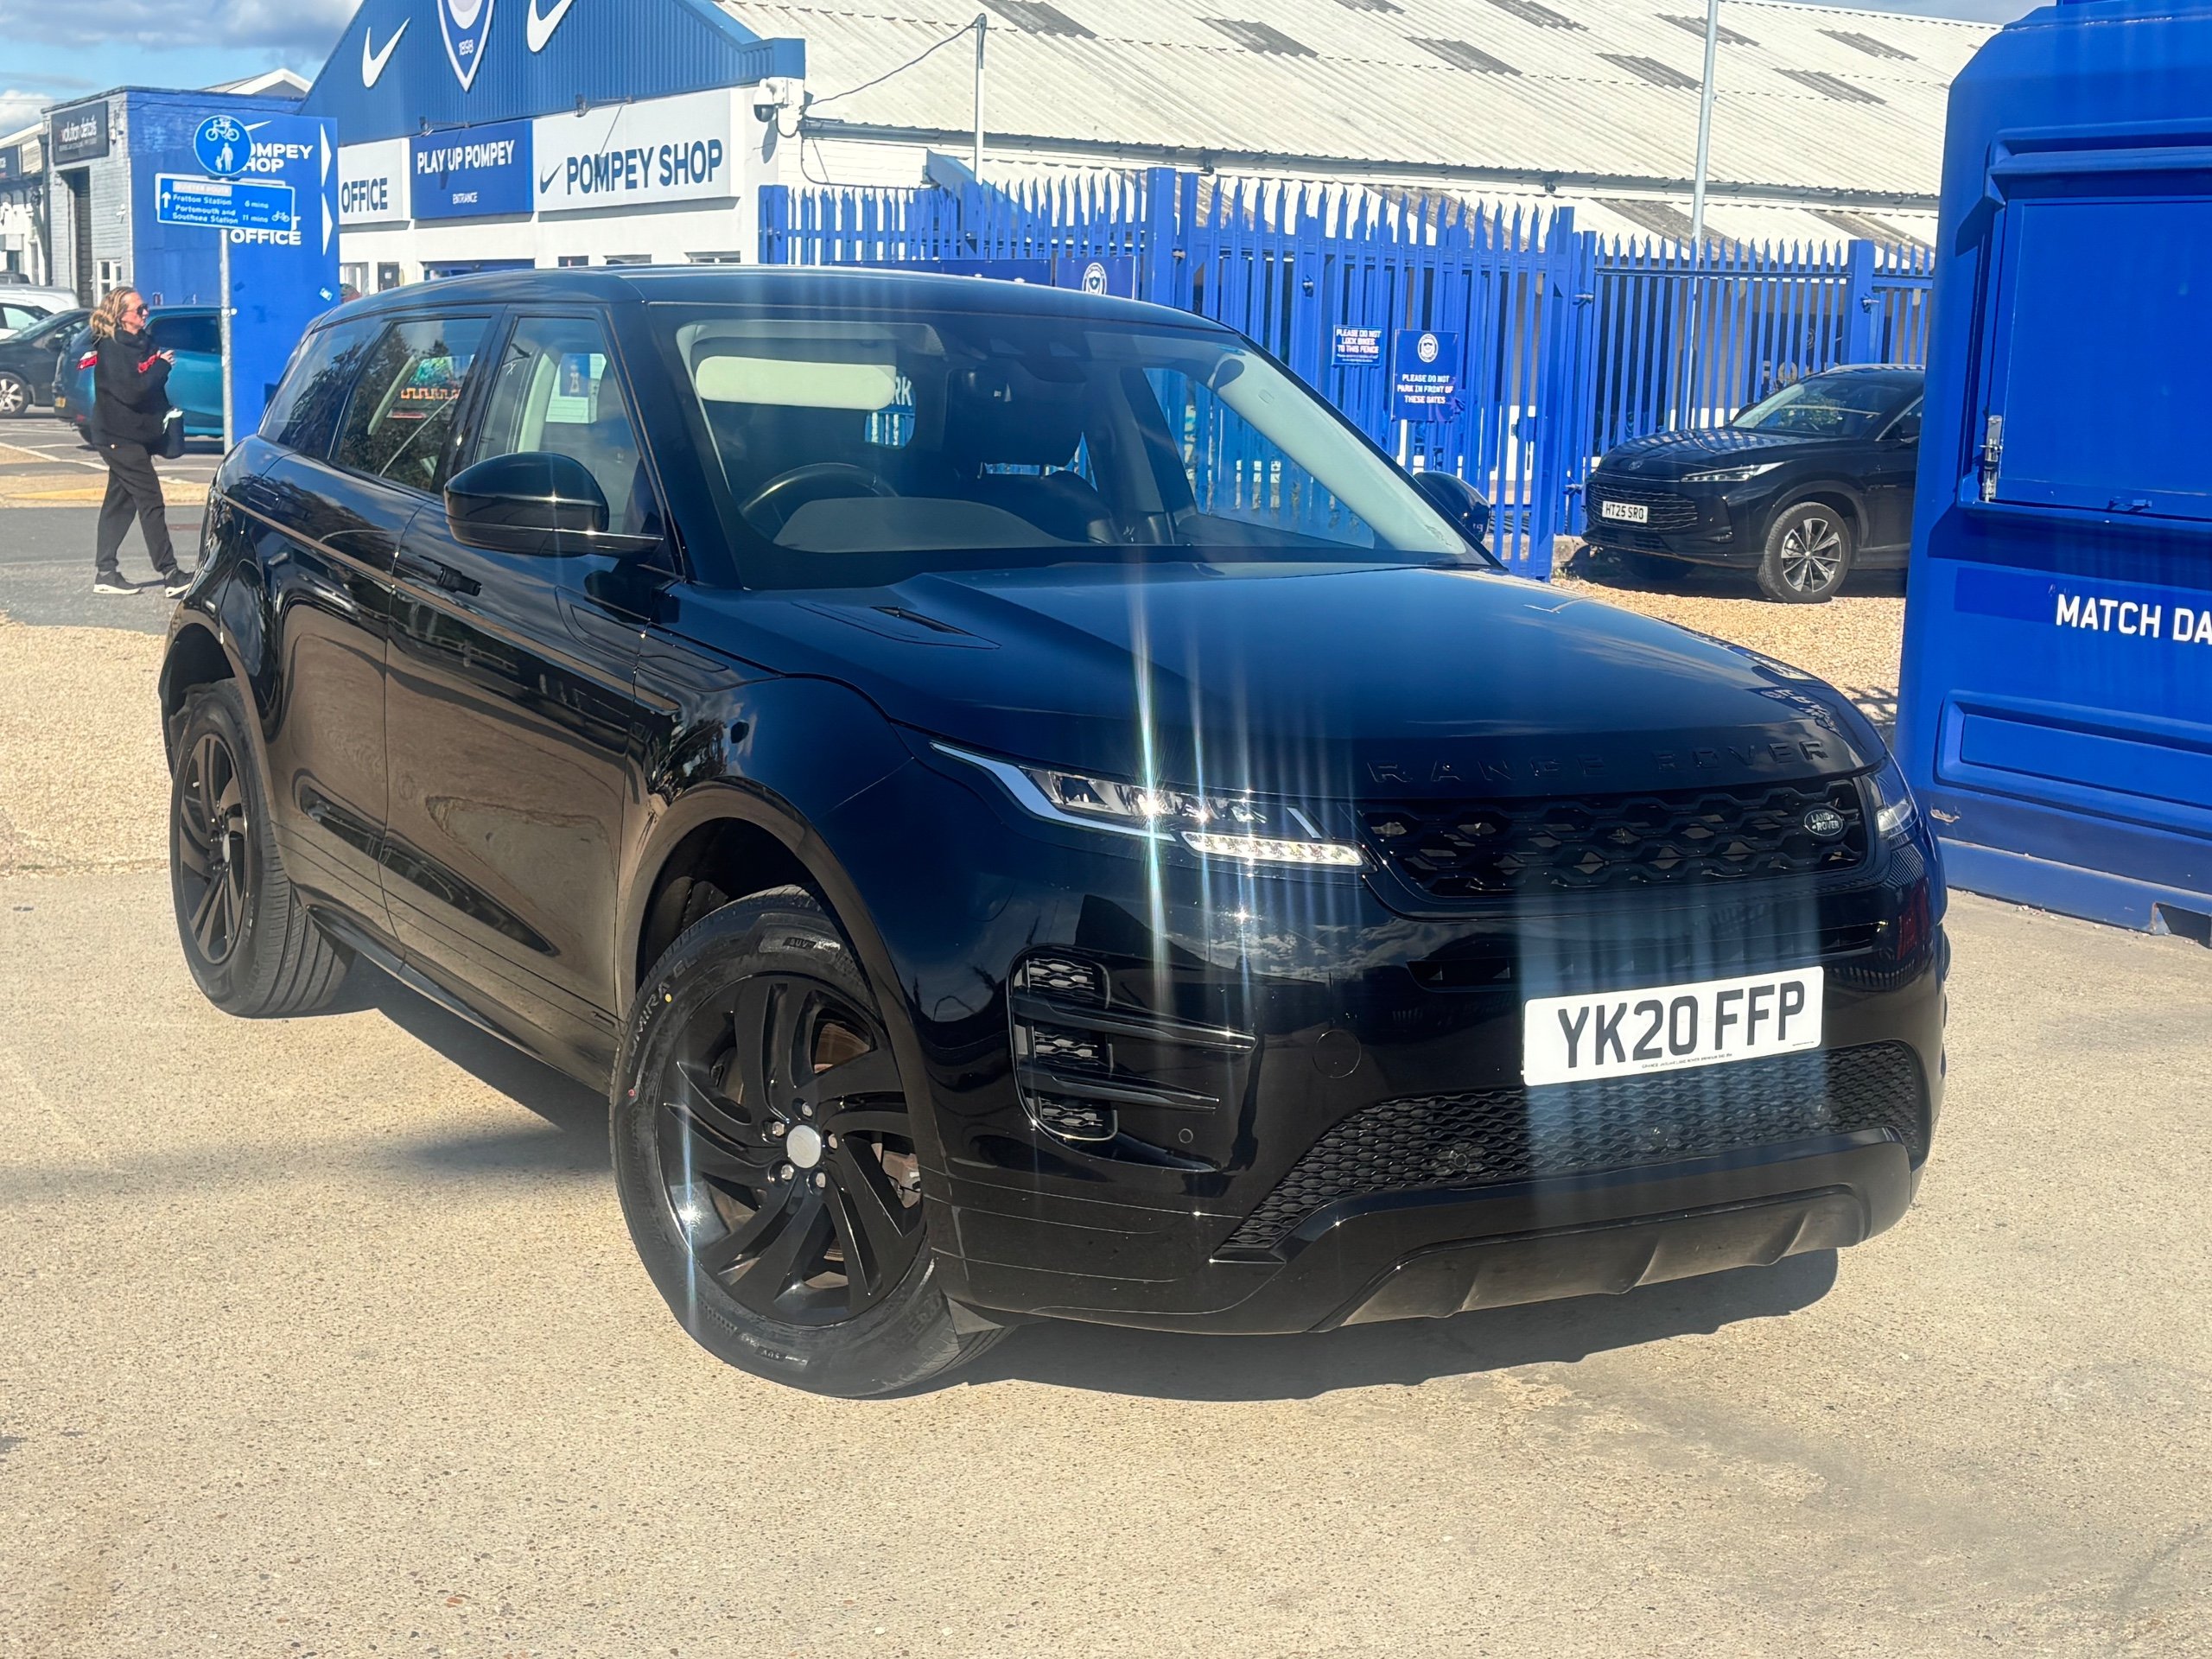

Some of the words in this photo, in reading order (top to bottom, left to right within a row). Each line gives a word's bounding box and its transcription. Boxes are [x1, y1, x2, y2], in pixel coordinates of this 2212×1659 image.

[458, 39, 474, 56] 1898
[251, 143, 314, 159] MPEY
[416, 148, 446, 175] PLAY
[447, 147, 463, 171] UP
[464, 140, 515, 169] POMPEY
[242, 157, 285, 173] HOP
[567, 146, 655, 195] POMPEY
[658, 139, 723, 187] SHOP
[173, 194, 202, 203] Fratton
[203, 196, 232, 206] Station
[341, 177, 388, 213] OFFICE
[452, 192, 478, 205] ENTRANCE
[175, 204, 219, 215] Portsmouth
[173, 213, 208, 223] Southsea
[210, 214, 238, 225] Station
[230, 229, 302, 245] OFFICE
[1336, 328, 1358, 337] PLEASE
[1369, 330, 1382, 339] NOT
[1341, 336, 1357, 345] LOCK
[1357, 337, 1376, 346] BIKES
[1337, 344, 1345, 353] TO
[1360, 346, 1380, 354] FENCE
[1402, 373, 1427, 383] PLEASE
[1427, 374, 1437, 383] DO
[1396, 384, 1414, 392] PARK
[1424, 385, 1445, 393] FRONT
[1445, 385, 1454, 394] OF
[1404, 395, 1426, 404] THESE
[1426, 396, 1446, 404] GATES
[1605, 503, 1626, 518] HT25
[1628, 506, 1644, 520] SRO
[2056, 594, 2162, 639] MATCH
[1652, 740, 1829, 771] ROVER
[1810, 812, 1831, 823] LAND
[1815, 820, 1840, 831] ROVER
[1557, 995, 1699, 1069] YK20
[1714, 981, 1805, 1051] FFP
